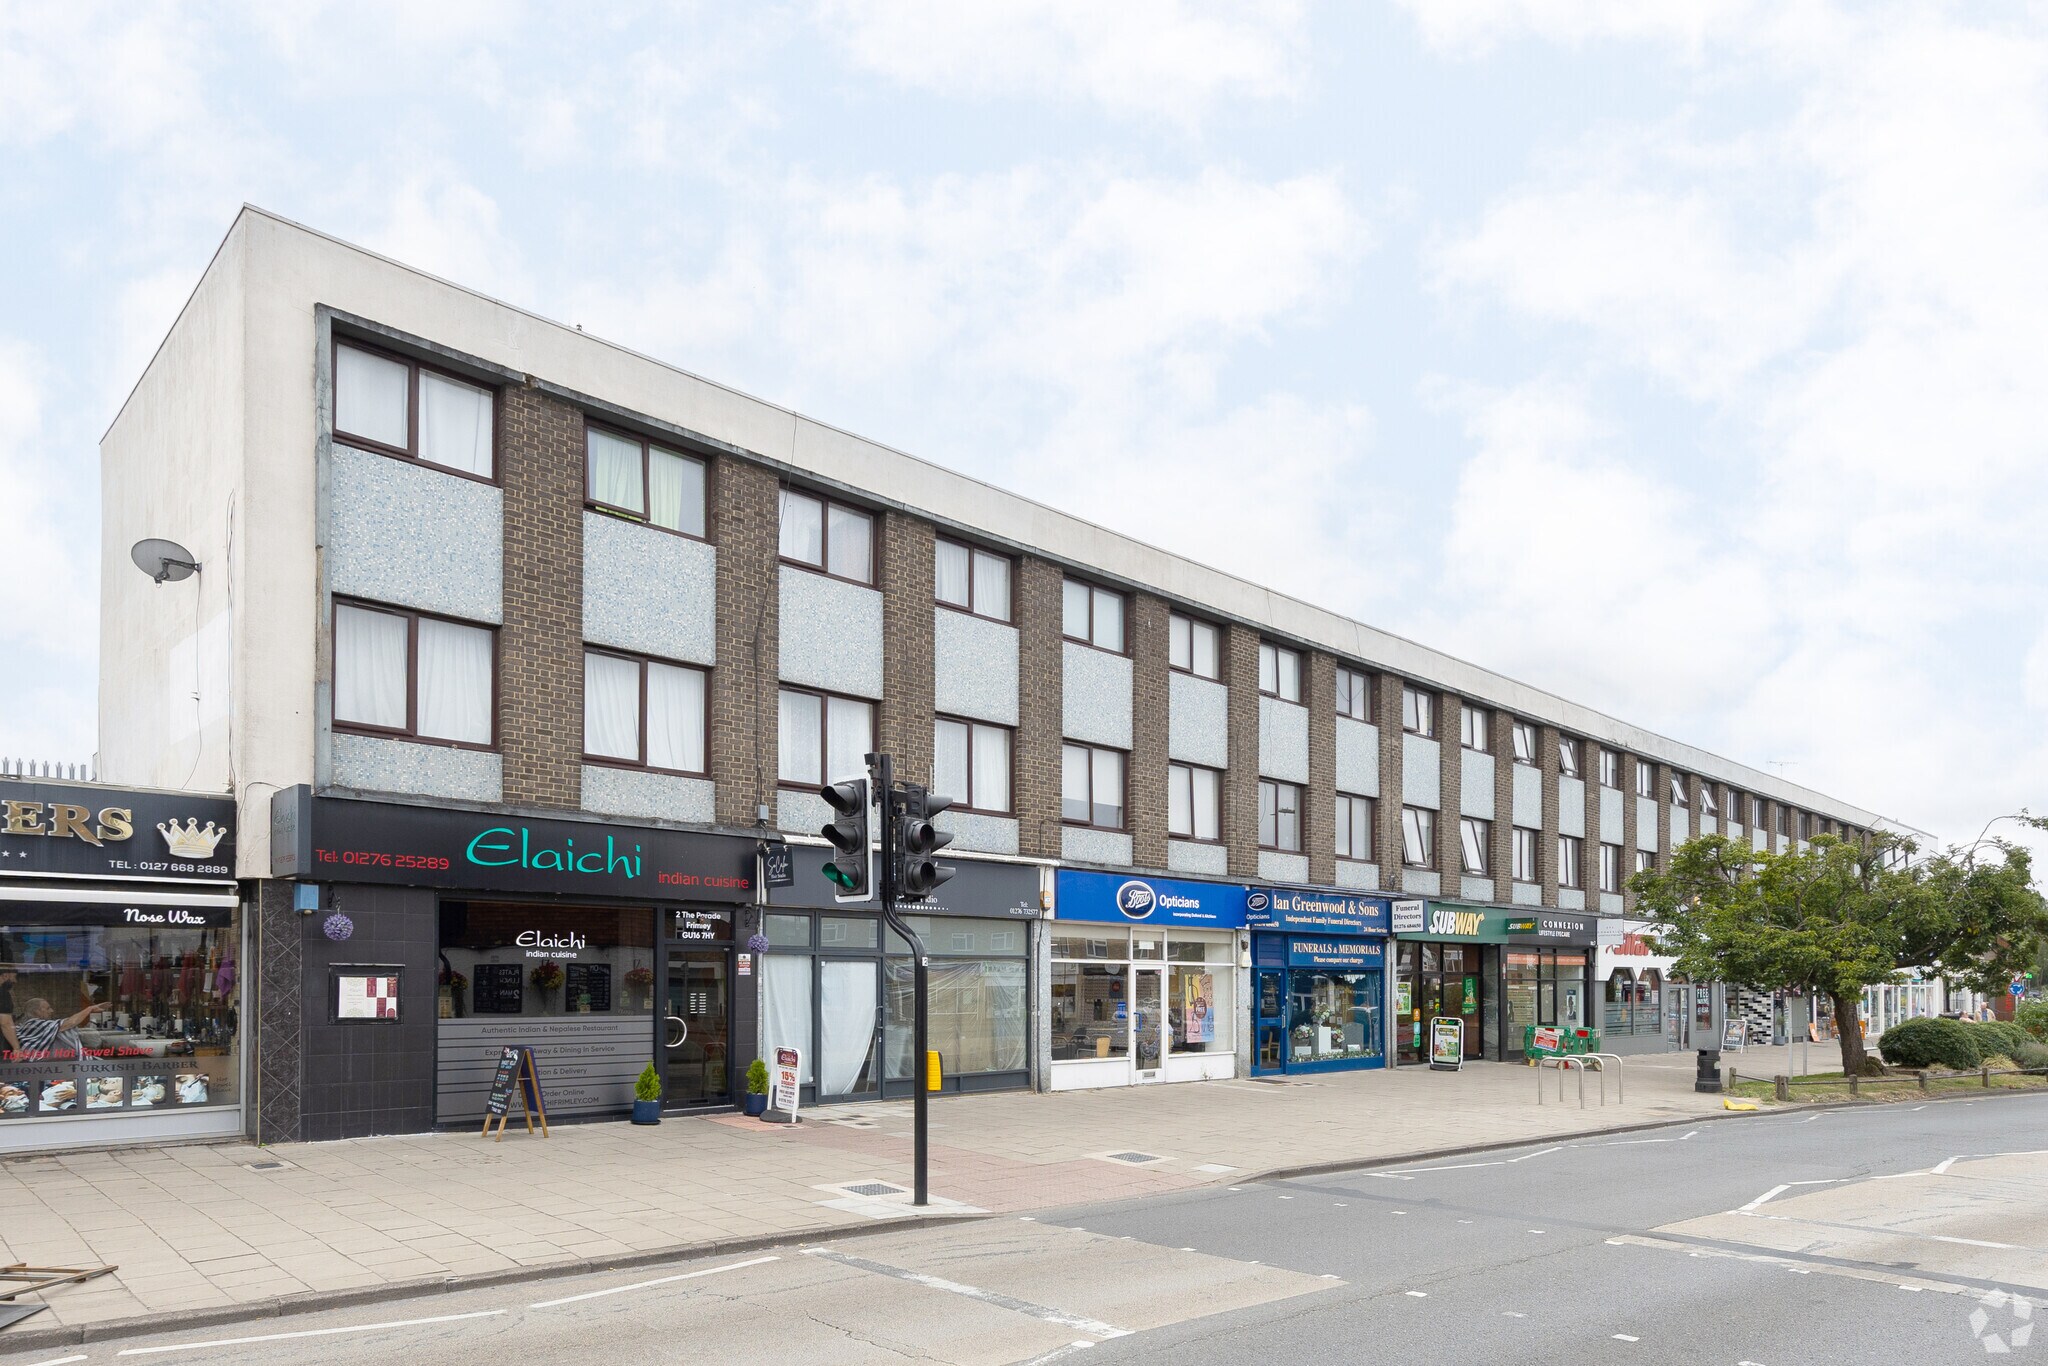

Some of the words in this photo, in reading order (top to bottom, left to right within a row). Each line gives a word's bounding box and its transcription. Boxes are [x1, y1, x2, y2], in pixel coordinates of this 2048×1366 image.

[315, 849, 338, 863] Tel:
[343, 851, 391, 866] 01276
[395, 854, 449, 869] 25289
[466, 827, 642, 880] Elaichi
[140, 861, 168, 871] 0127
[171, 863, 194, 872] 668
[197, 864, 228, 874] 2889
[658, 871, 700, 886] indian
[704, 876, 749, 889] cuisine
[1125, 889, 1151, 909] Boots
[1160, 894, 1199, 909] Opticians
[1274, 894, 1289, 910] Ian
[1292, 896, 1346, 914] Greenwood
[1348, 902, 1356, 914] &
[1359, 902, 1379, 916] Sons
[124, 908, 165, 923] Nose
[168, 910, 206, 925] Wax
[682, 911, 695, 919] The
[696, 912, 721, 920] Parade
[1286, 914, 1312, 924] Independent
[1313, 917, 1327, 925] Family
[1344, 918, 1362, 926] Directors
[1429, 910, 1485, 936] SUBWAY
[1508, 922, 1535, 930] SUBWAY
[1543, 920, 1584, 931] CONNEXION
[516, 930, 586, 949] Elaichi
[526, 950, 549, 958] indian
[1293, 943, 1332, 954] FUNERALS
[1339, 944, 1380, 955] MEMORIALS
[1696, 988, 1708, 998] FREE
[3, 1048, 50, 1060] Turkish
[54, 1048, 75, 1058] Hot
[81, 1047, 114, 1057] Towel
[118, 1046, 153, 1056] Shave
[67, 1062, 135, 1074] TURKISH
[142, 1060, 198, 1072] BARBER
[560, 1068, 588, 1076] Delivery
[781, 1071, 795, 1082] 15%
